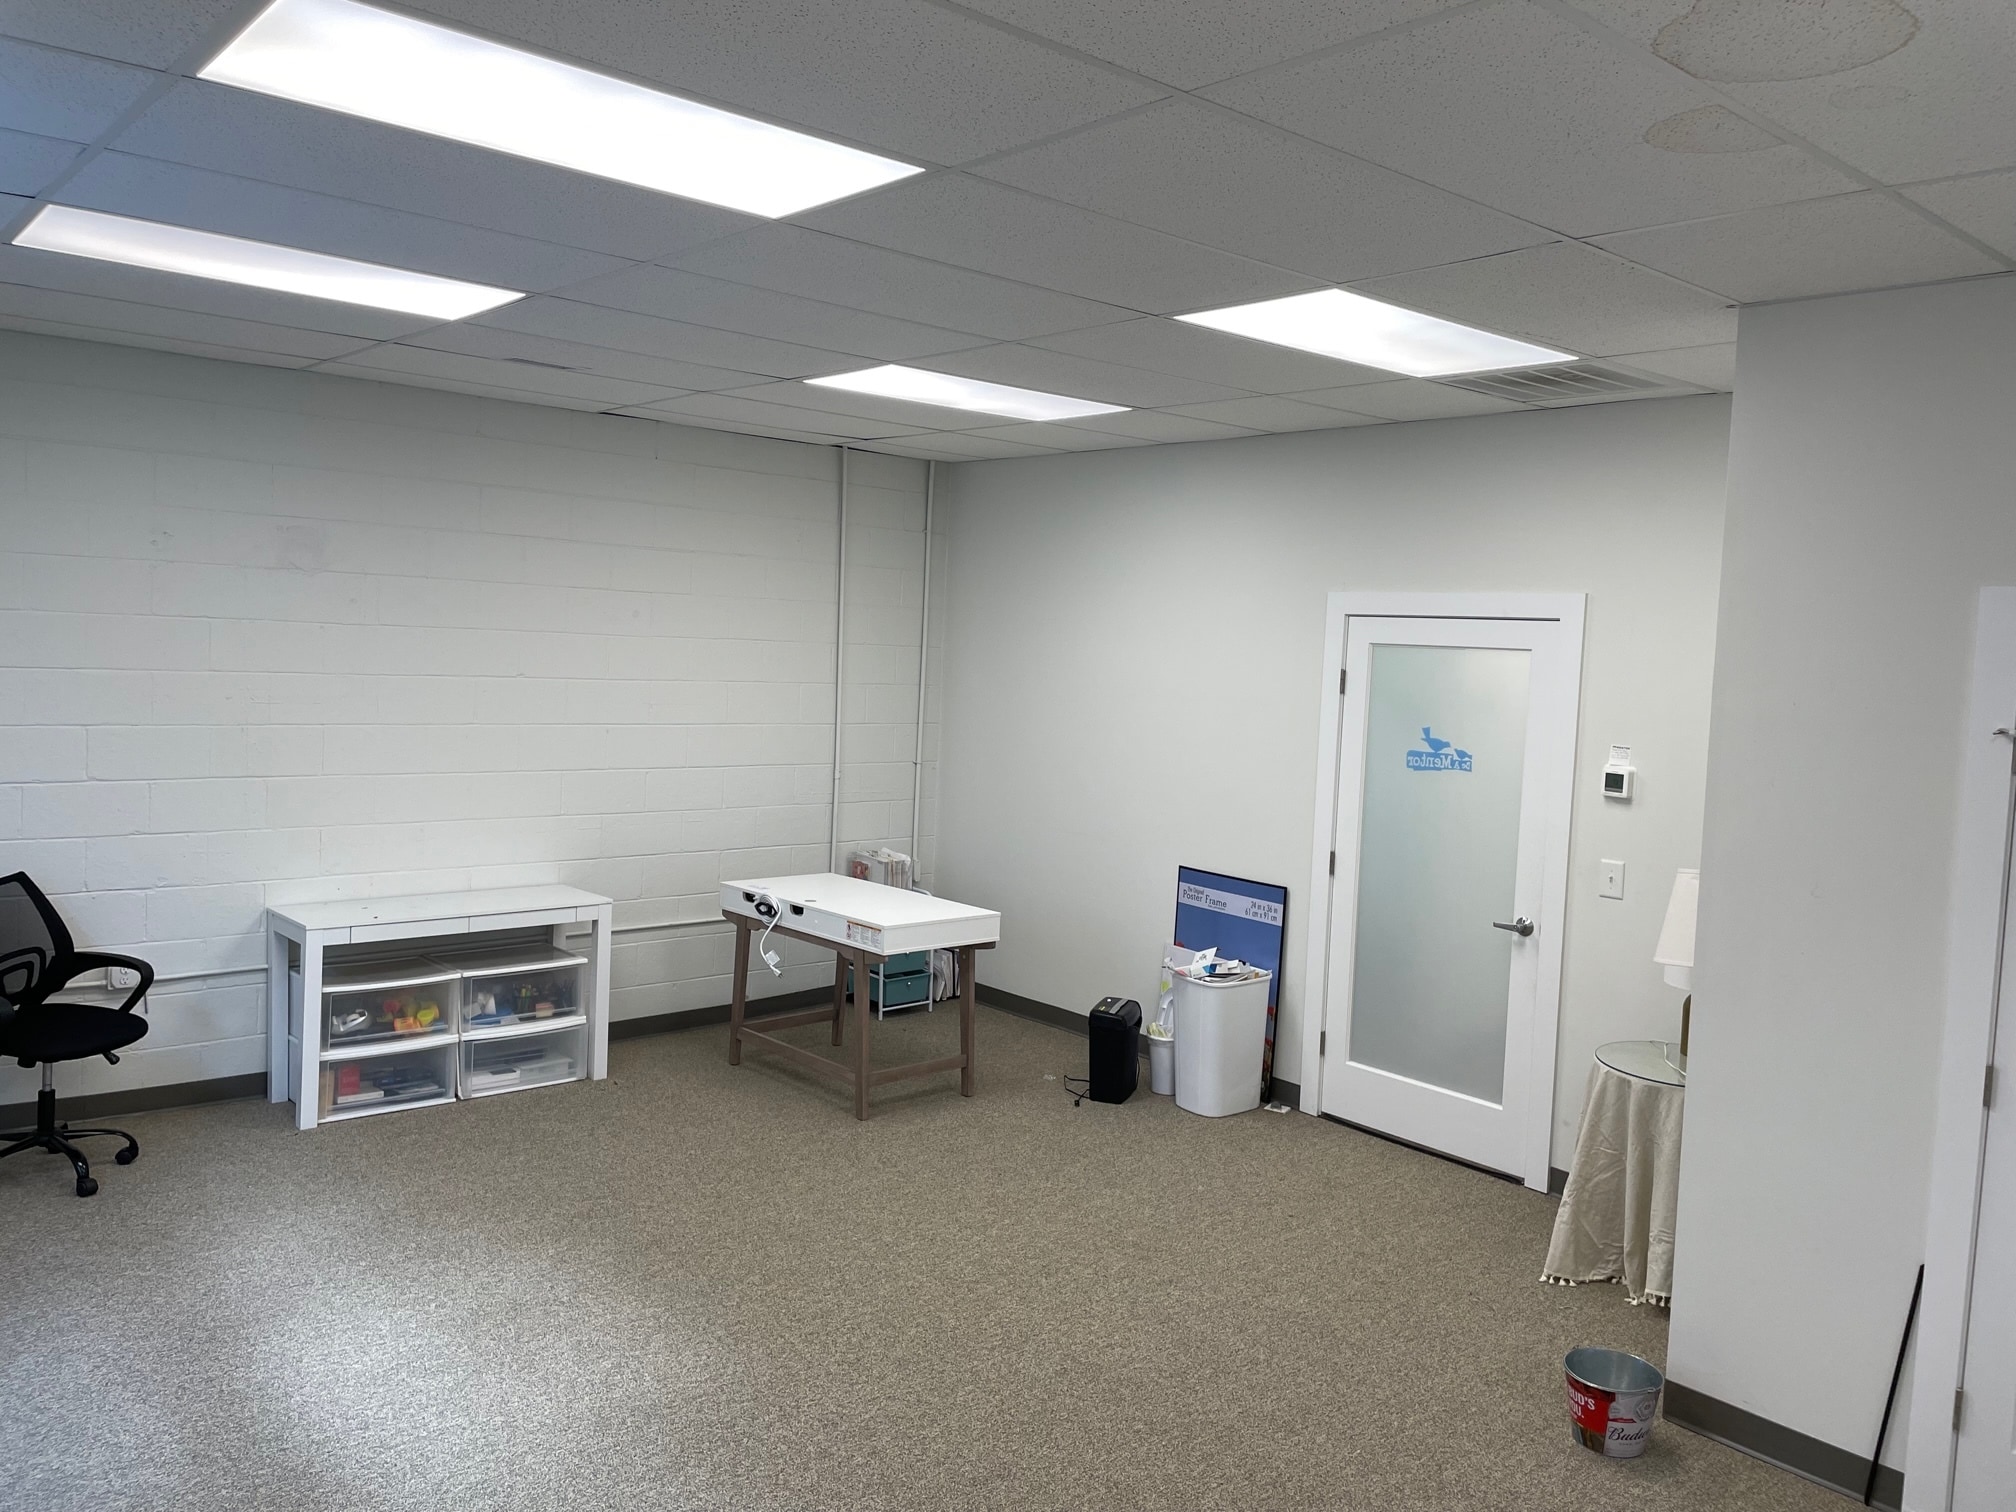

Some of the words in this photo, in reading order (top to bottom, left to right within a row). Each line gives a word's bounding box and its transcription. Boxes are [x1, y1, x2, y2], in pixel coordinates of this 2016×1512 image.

[1183, 889, 1203, 902] Poster
[1205, 894, 1227, 908] Frame
[1250, 900, 1257, 910] 24
[1266, 904, 1273, 914] 36
[1244, 908, 1251, 916] 61
[1263, 911, 1270, 921] 91
